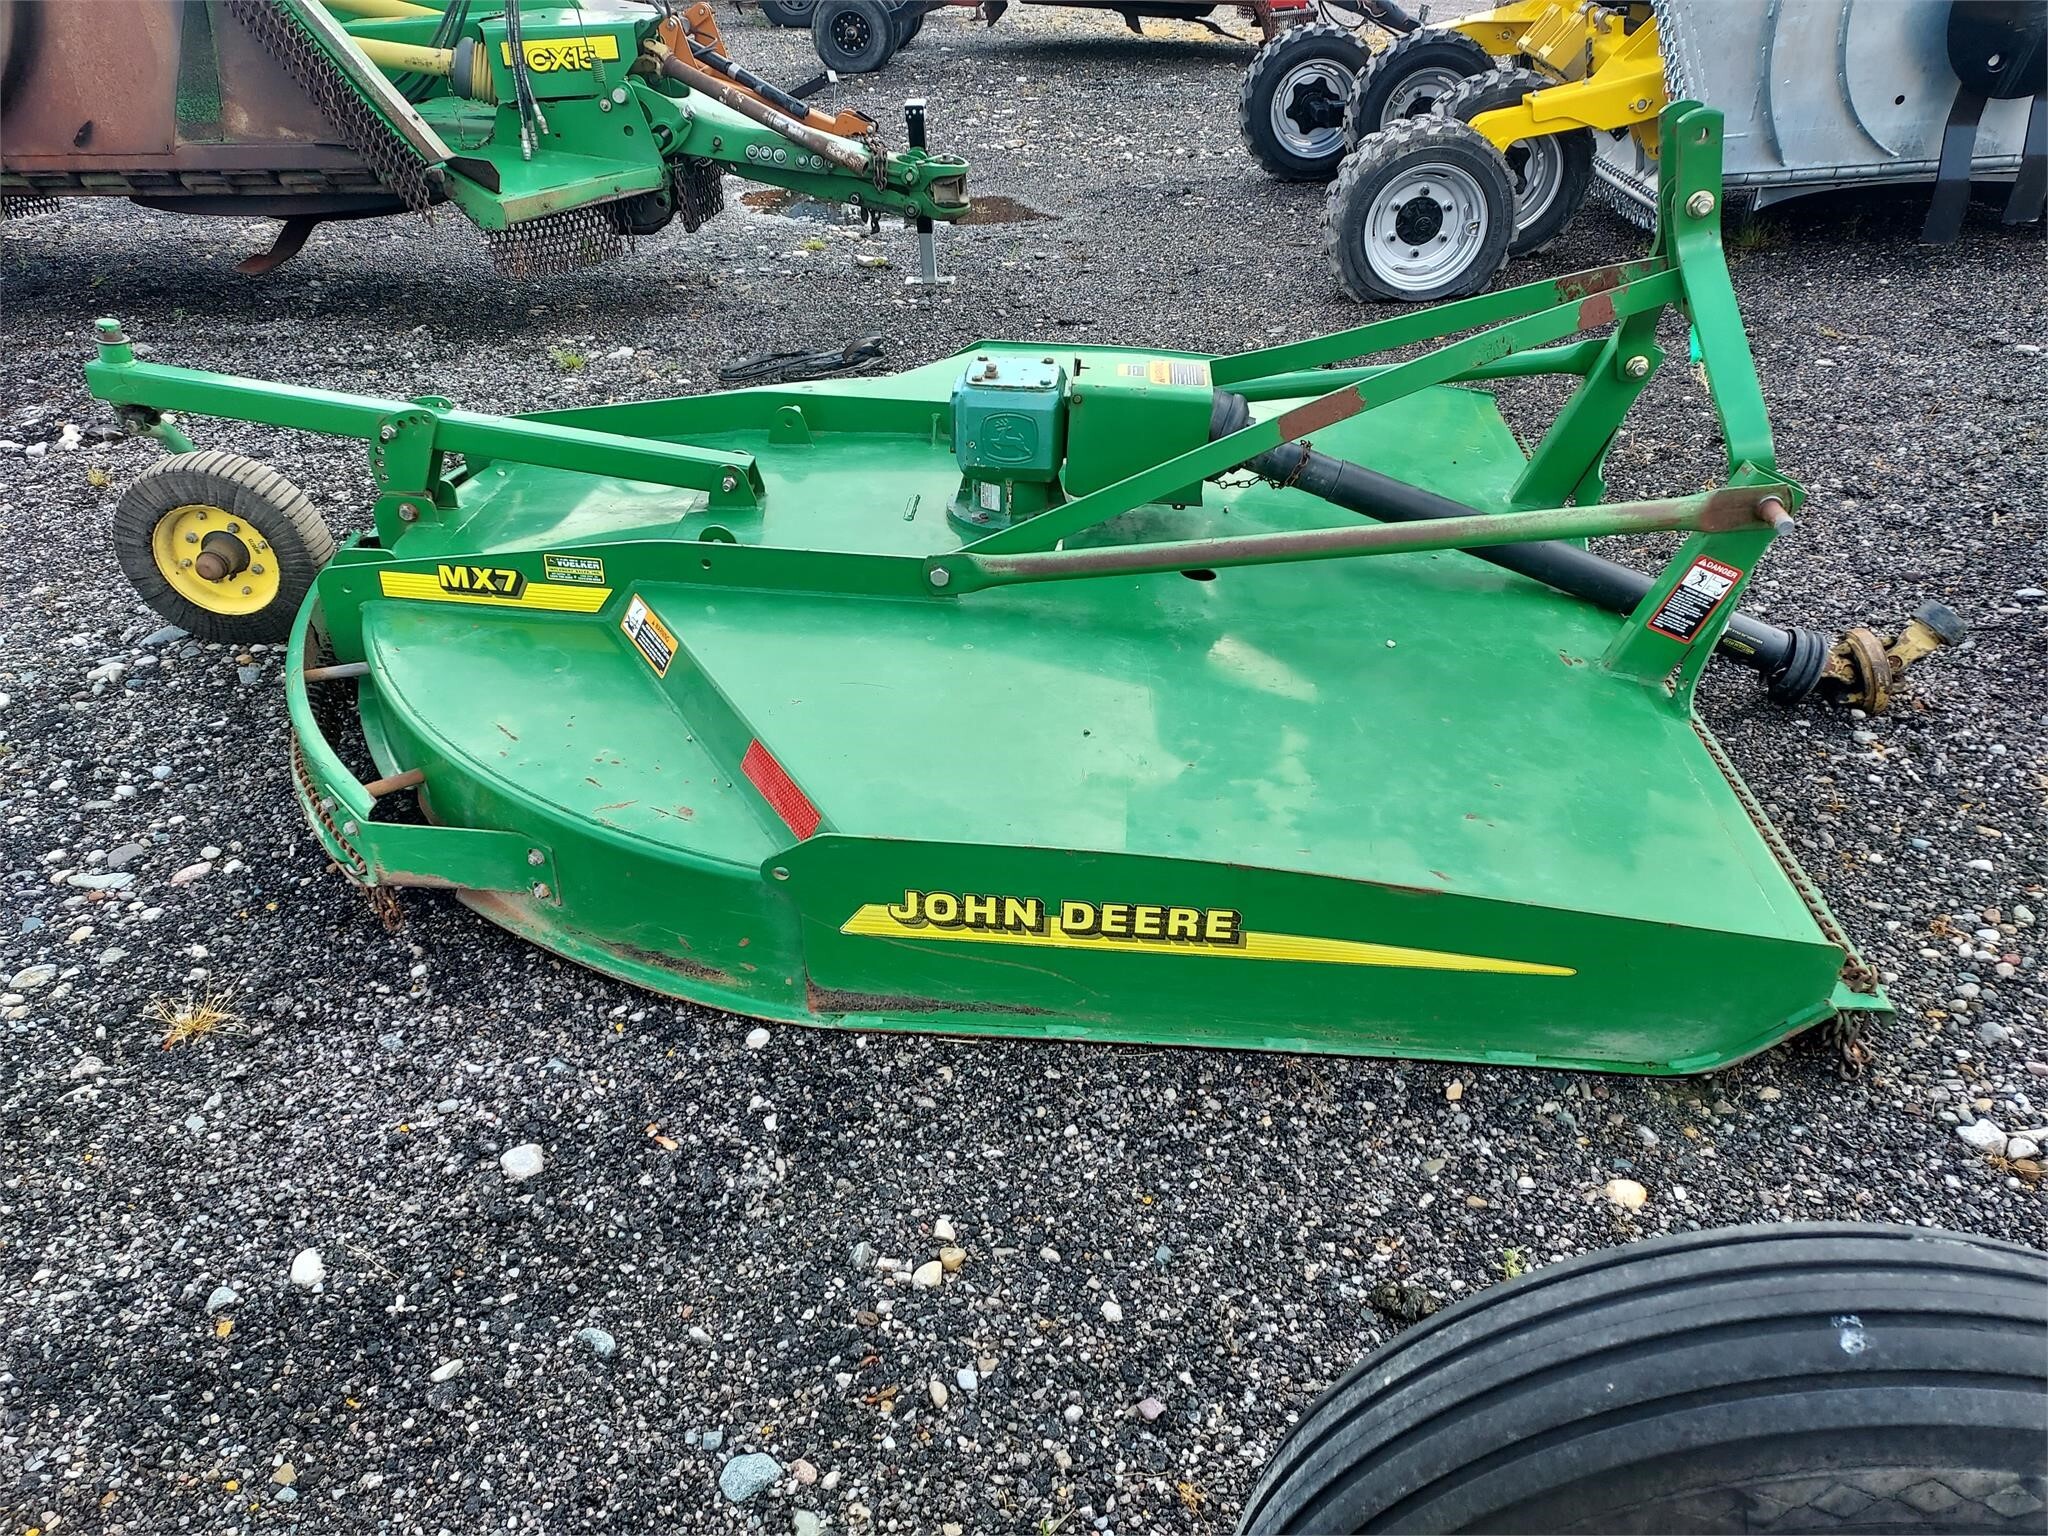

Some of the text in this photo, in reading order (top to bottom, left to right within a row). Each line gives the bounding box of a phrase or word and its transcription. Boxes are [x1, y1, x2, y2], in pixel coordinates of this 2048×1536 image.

[527, 45, 596, 73] CX15
[556, 558, 600, 570] VOELKER
[1706, 561, 1738, 579] DANGER
[437, 564, 522, 595] MX7
[889, 890, 1241, 944] JOHN DEERE
